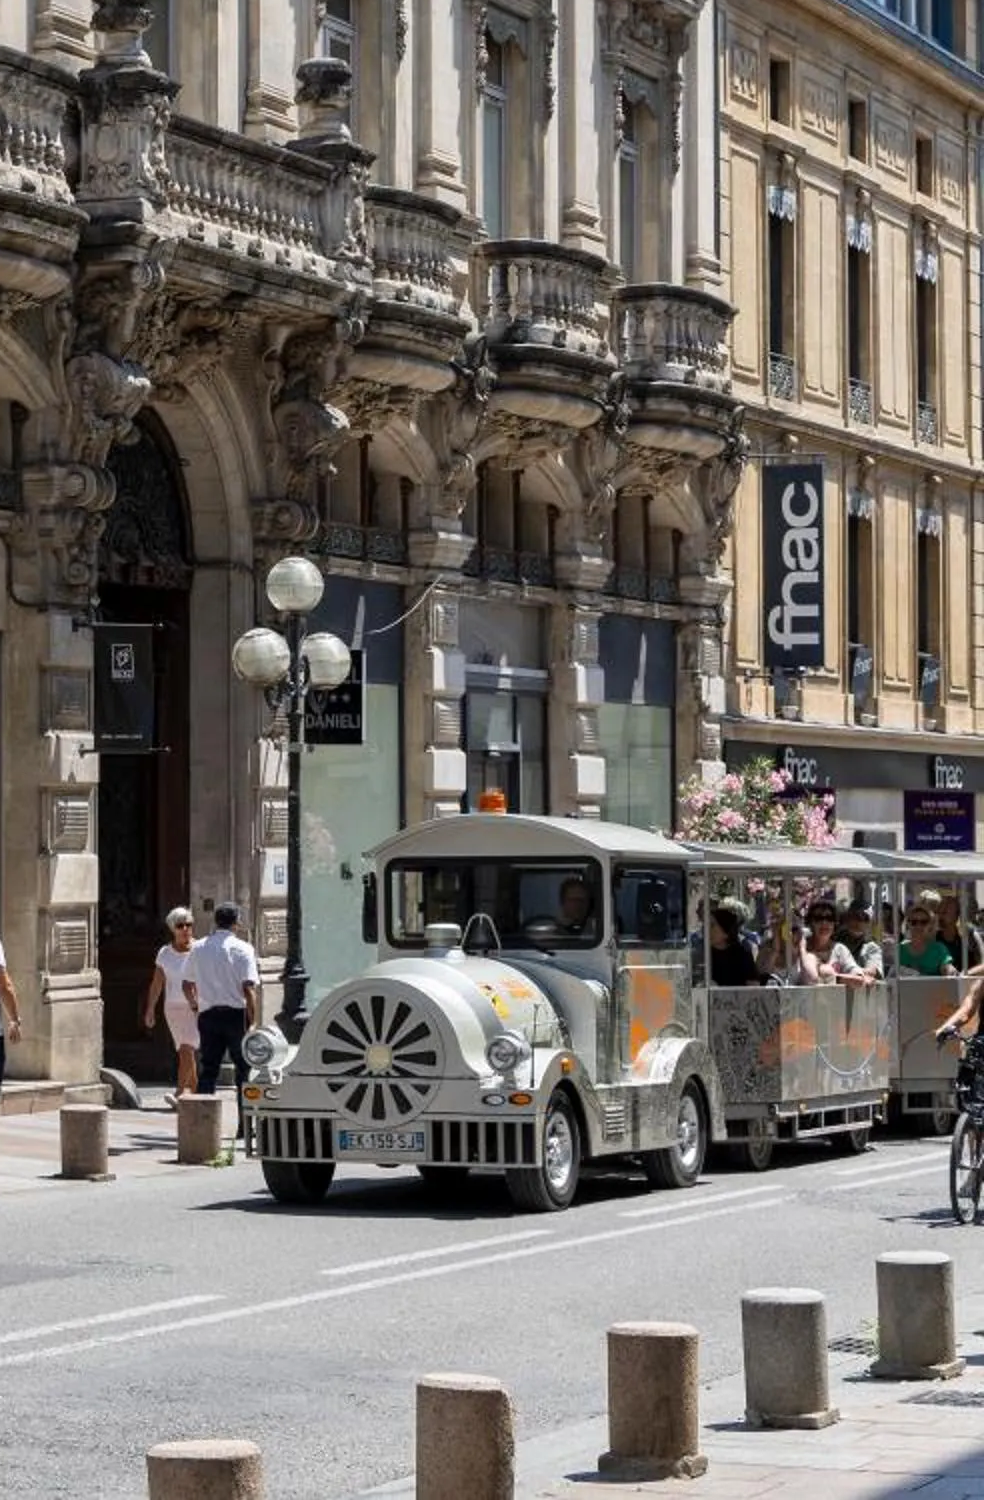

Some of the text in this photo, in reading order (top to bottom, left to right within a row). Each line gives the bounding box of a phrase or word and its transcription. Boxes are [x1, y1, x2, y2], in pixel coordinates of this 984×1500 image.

[768, 481, 820, 651] fnac
[784, 747, 817, 784] fnac
[935, 755, 963, 788] fnac
